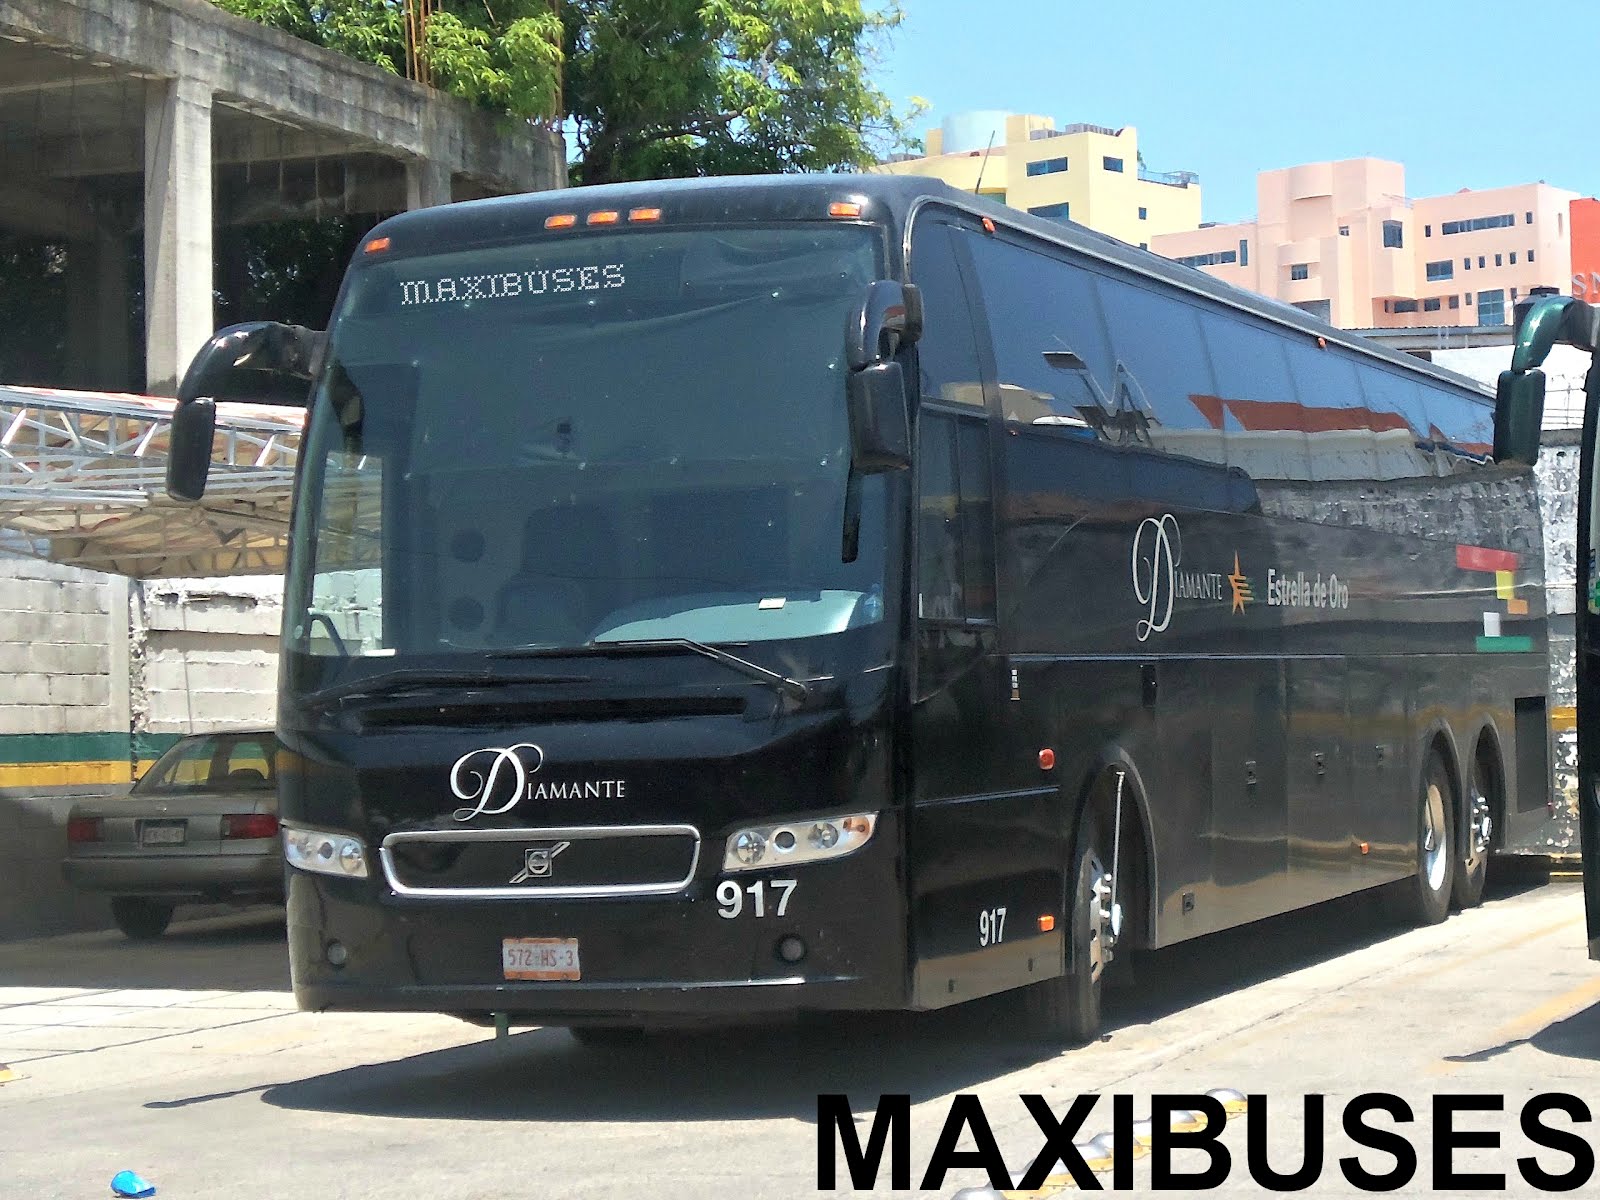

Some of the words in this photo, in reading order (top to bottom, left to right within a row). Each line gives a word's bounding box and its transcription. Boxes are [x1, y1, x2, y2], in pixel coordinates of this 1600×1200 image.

[400, 263, 625, 305] MAXIBUSES
[1132, 513, 1223, 642] DIAMANTE
[1267, 568, 1311, 607] Estrella
[1312, 573, 1327, 609] de
[1329, 573, 1350, 609] Oro
[450, 743, 626, 822] DIAMANTE
[716, 880, 798, 919] 917
[980, 907, 1007, 947] 917
